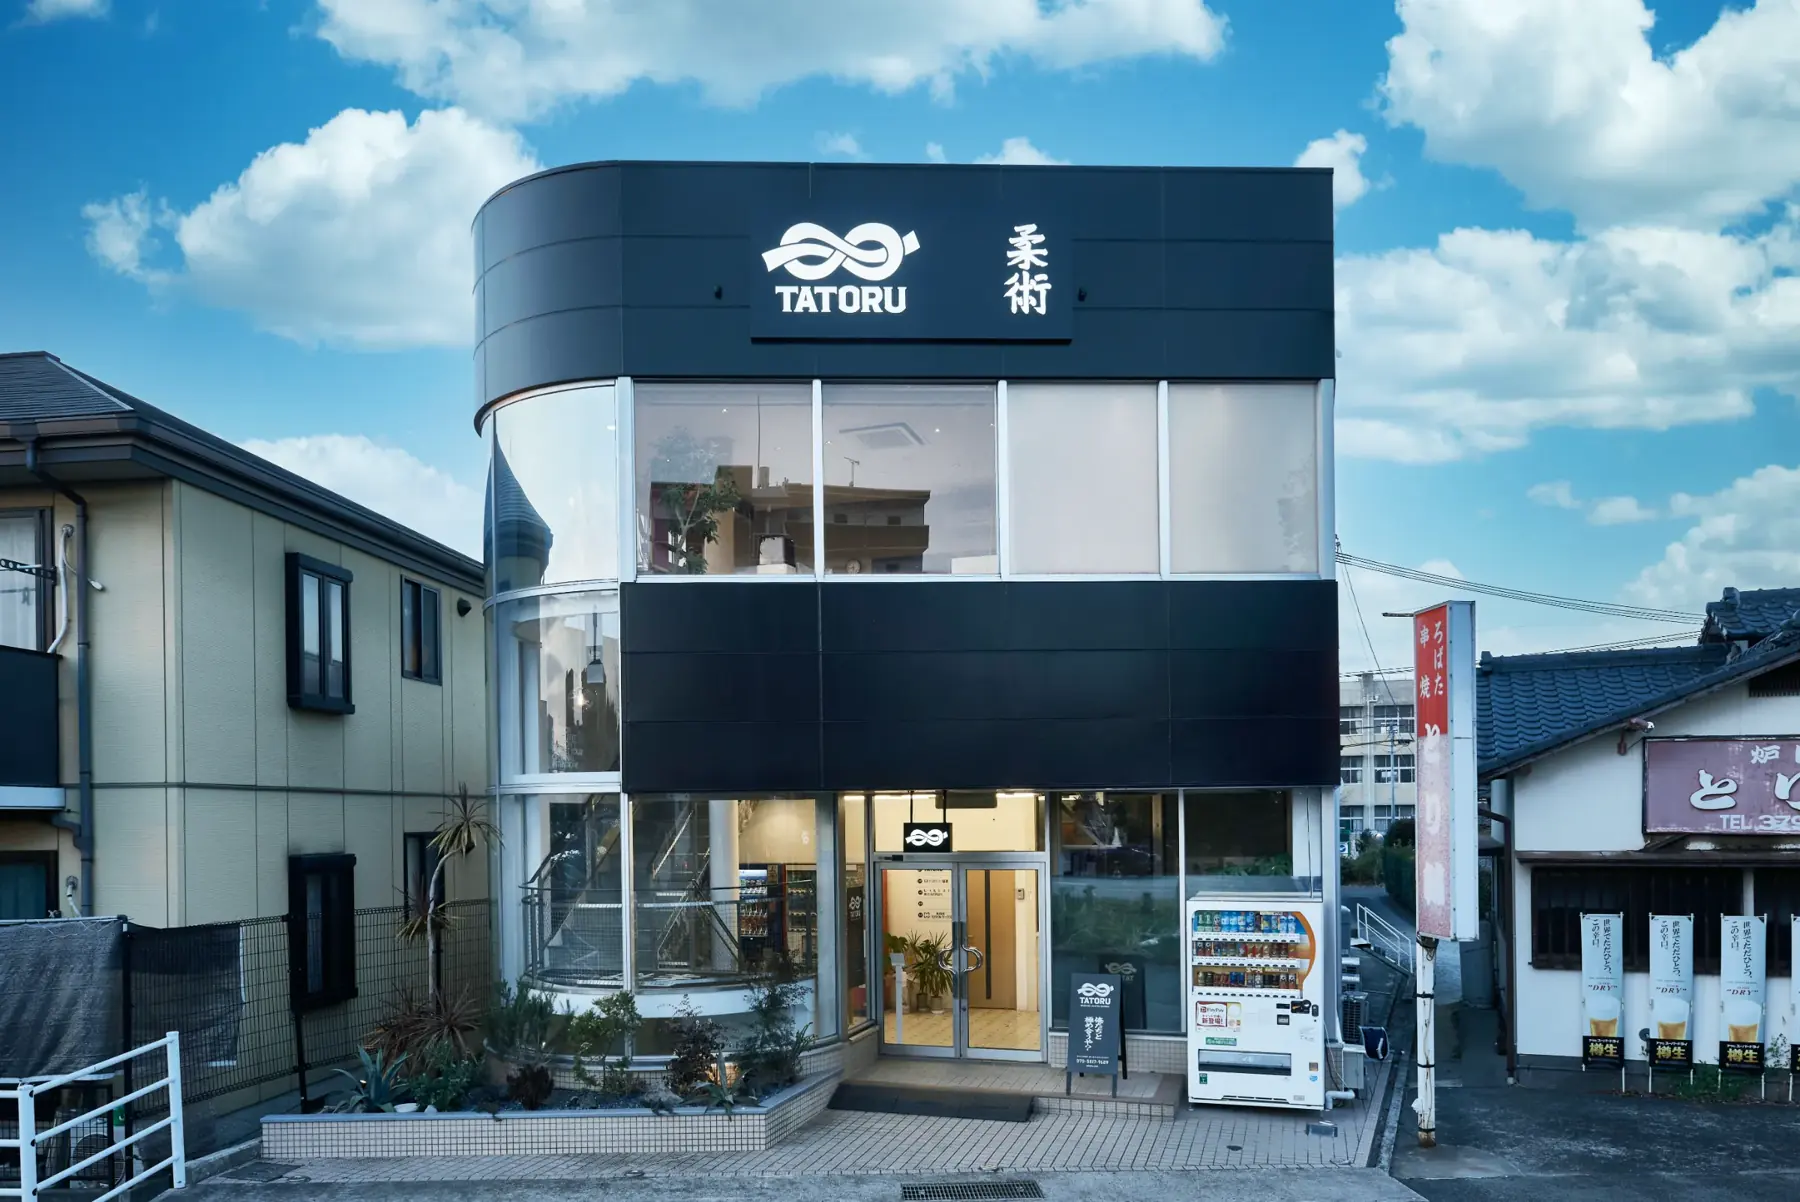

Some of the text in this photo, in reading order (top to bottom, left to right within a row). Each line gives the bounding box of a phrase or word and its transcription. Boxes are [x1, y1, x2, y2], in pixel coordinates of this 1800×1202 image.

[1003, 223, 1052, 315] 柔術
[775, 285, 907, 314] TATORU
[1419, 626, 1431, 699] 串焼
[1433, 621, 1444, 696] ろばた
[1750, 745, 1800, 764] 炉
[1080, 997, 1111, 1005] TATORU
